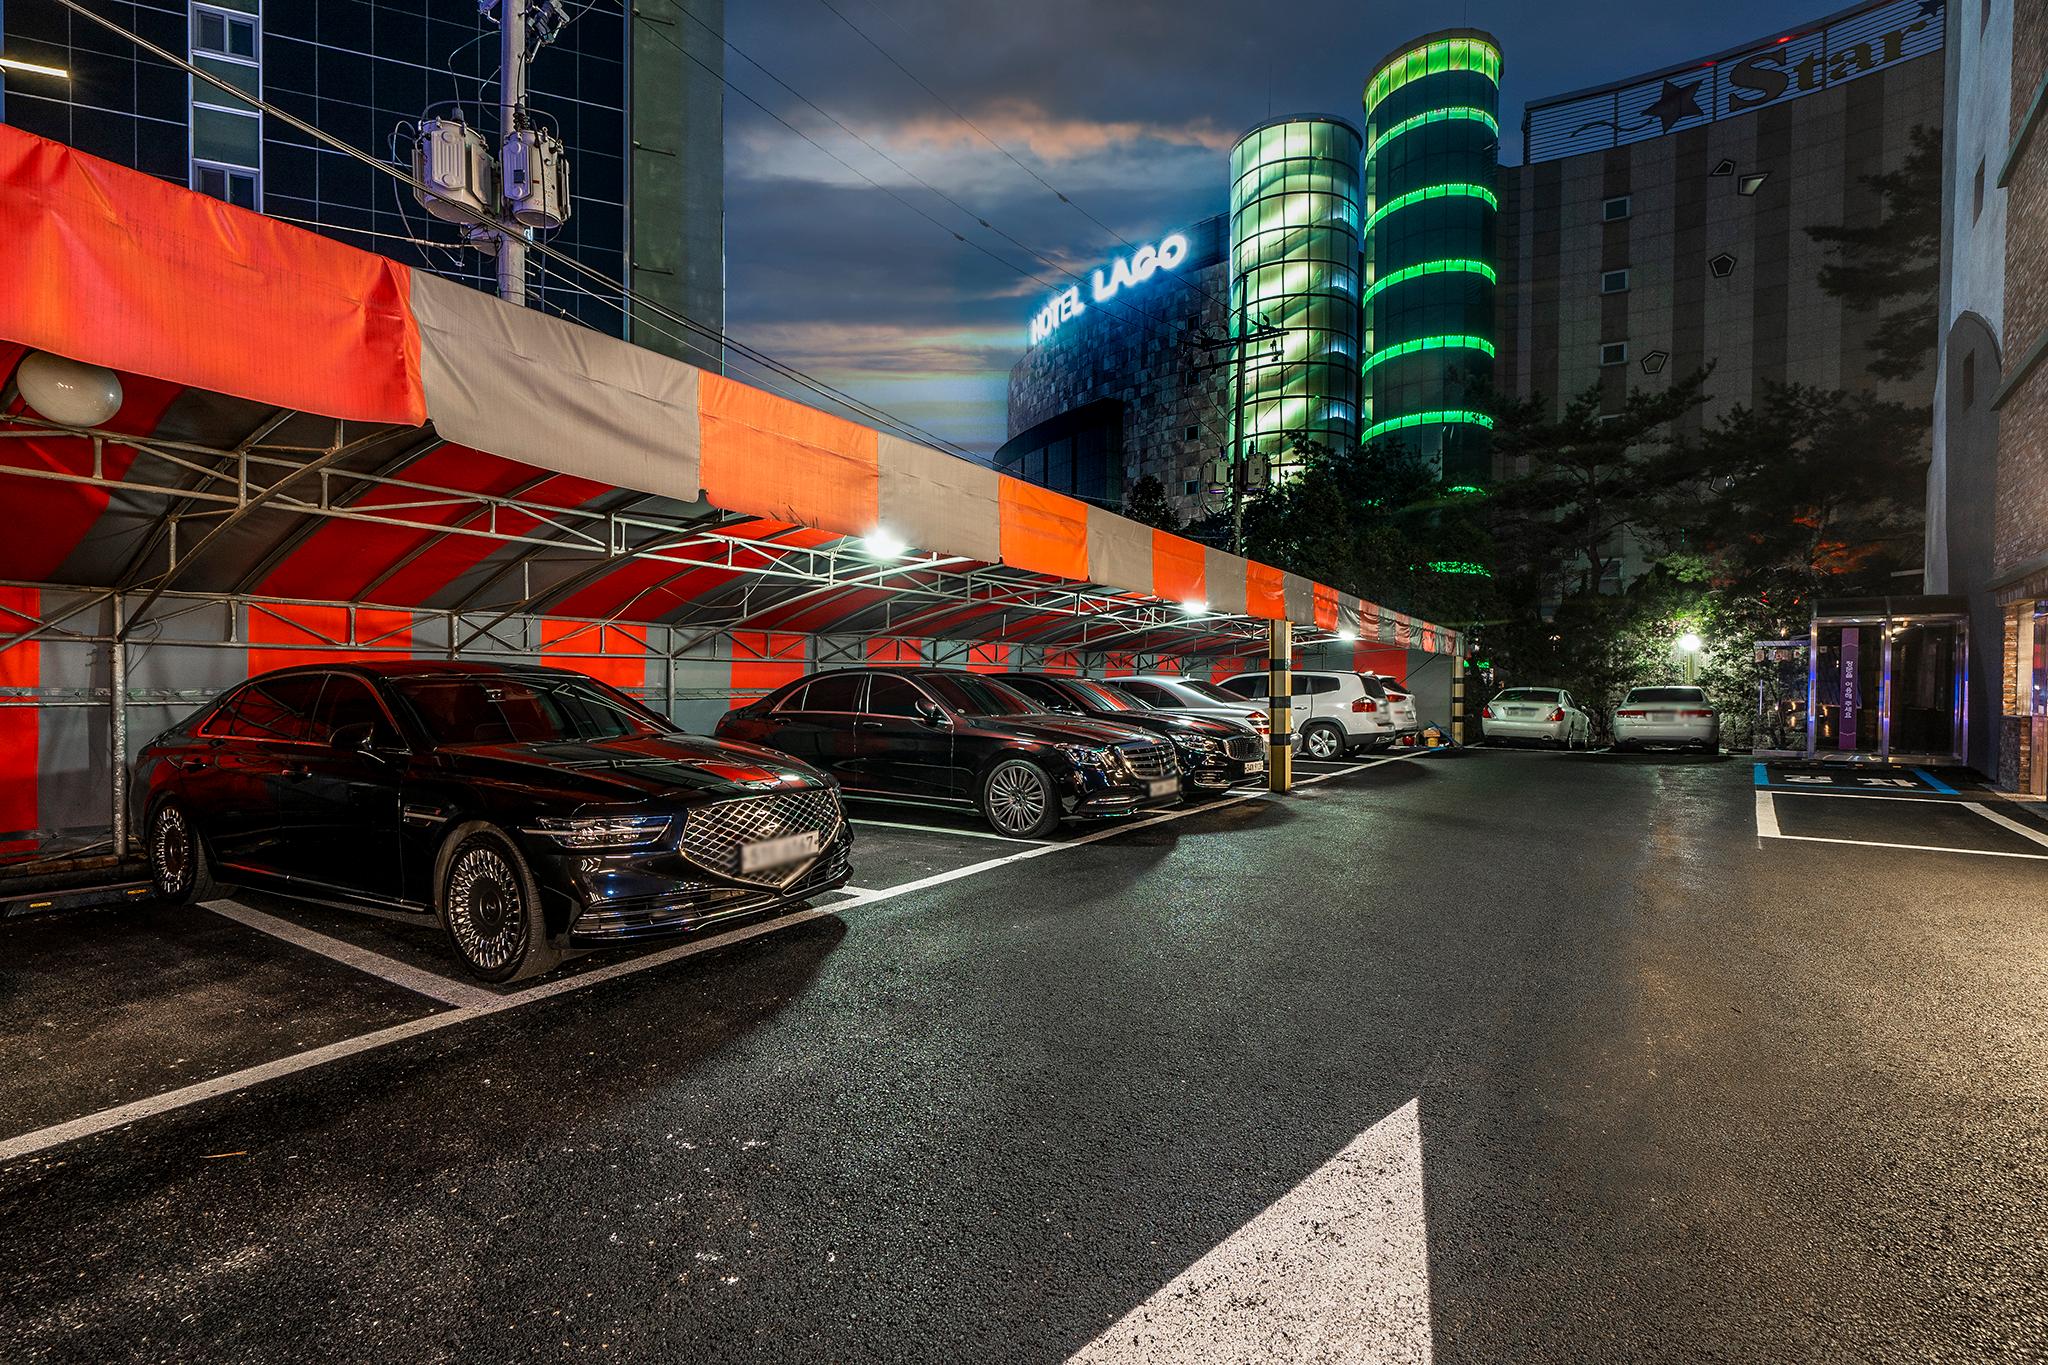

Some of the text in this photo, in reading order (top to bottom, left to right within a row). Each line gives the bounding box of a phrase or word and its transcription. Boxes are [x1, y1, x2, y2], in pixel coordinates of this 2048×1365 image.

[1729, 20, 1927, 112] Star
[1030, 234, 1187, 345] HOTEL LAGO
[1844, 701, 1853, 719] 주세요
